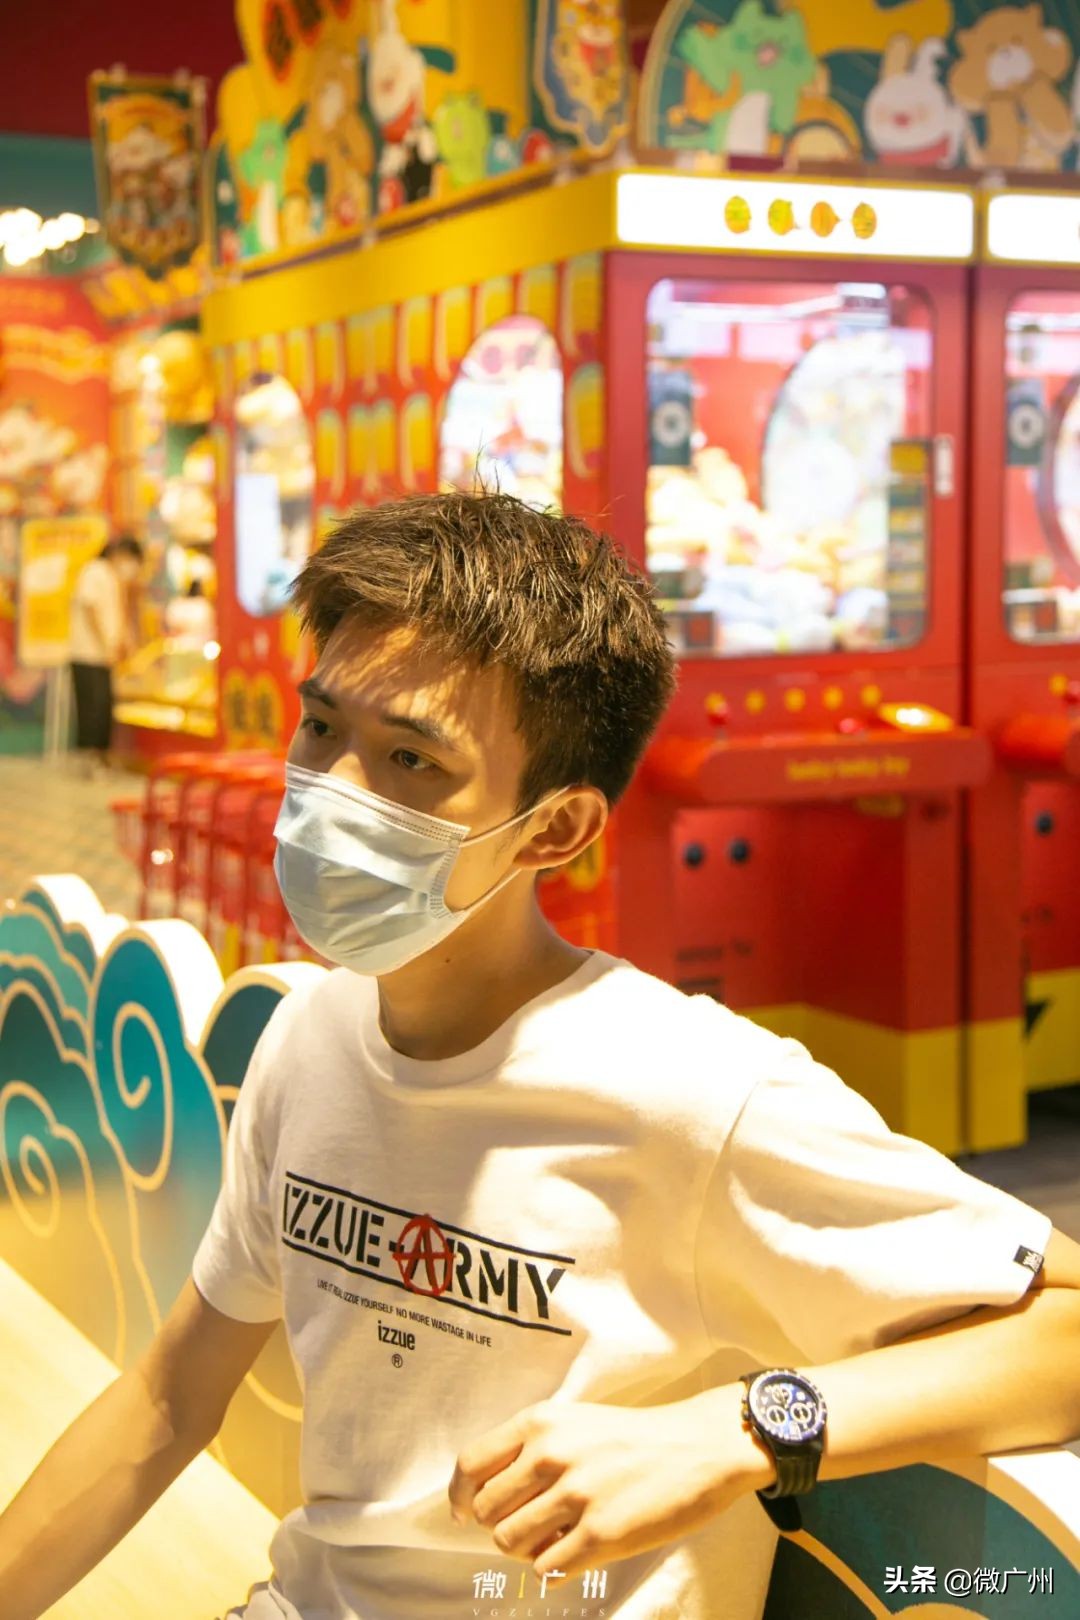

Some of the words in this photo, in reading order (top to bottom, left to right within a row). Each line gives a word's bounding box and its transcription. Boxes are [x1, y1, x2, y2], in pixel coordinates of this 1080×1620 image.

[343, 1291, 360, 1305] IZZUE
[360, 1296, 393, 1314] YOURSELF
[395, 1307, 407, 1319] NO
[409, 1310, 430, 1327] MORE
[431, 1318, 465, 1339] WASTAGE
[466, 1330, 474, 1342] IN
[475, 1334, 492, 1348] LIFE
[377, 1320, 416, 1351] izzue
